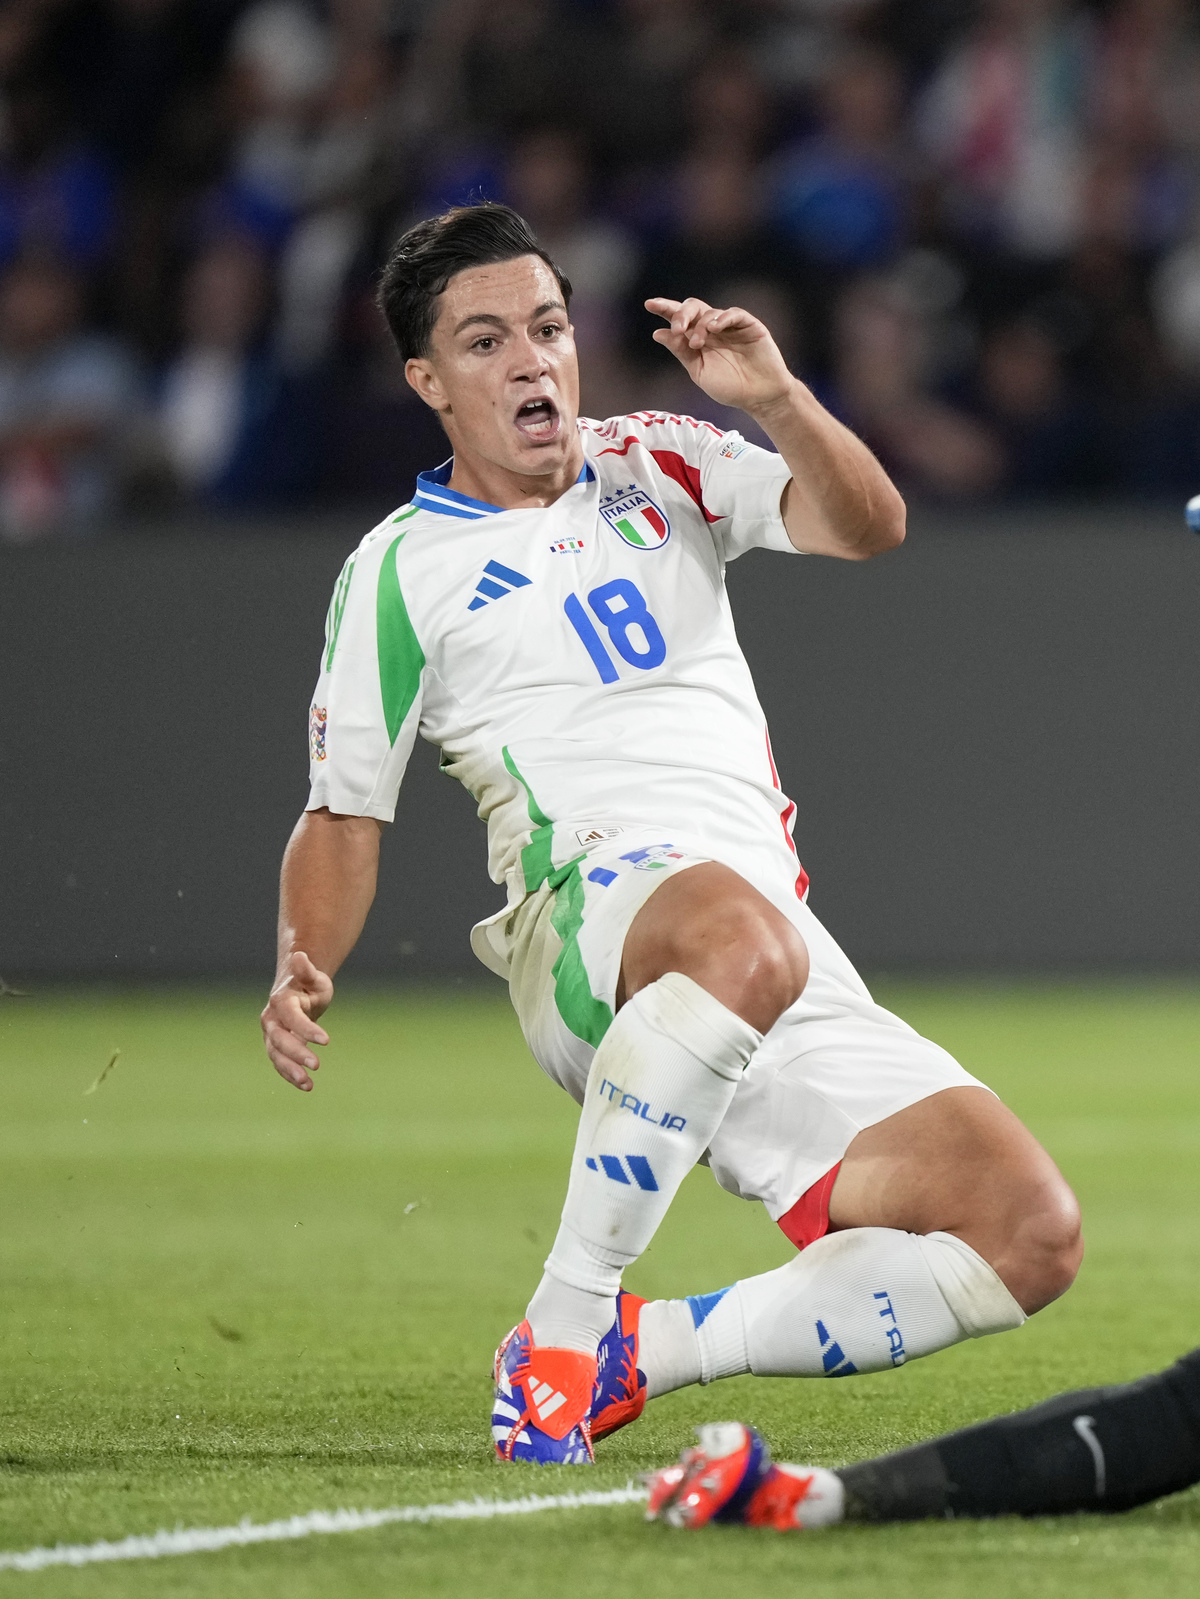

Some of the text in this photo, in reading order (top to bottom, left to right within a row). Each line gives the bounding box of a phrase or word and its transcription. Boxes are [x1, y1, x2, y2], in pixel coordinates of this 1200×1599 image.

[604, 496, 646, 519] ITALIA
[564, 578, 666, 684] 18
[599, 1078, 687, 1132] ITALIA
